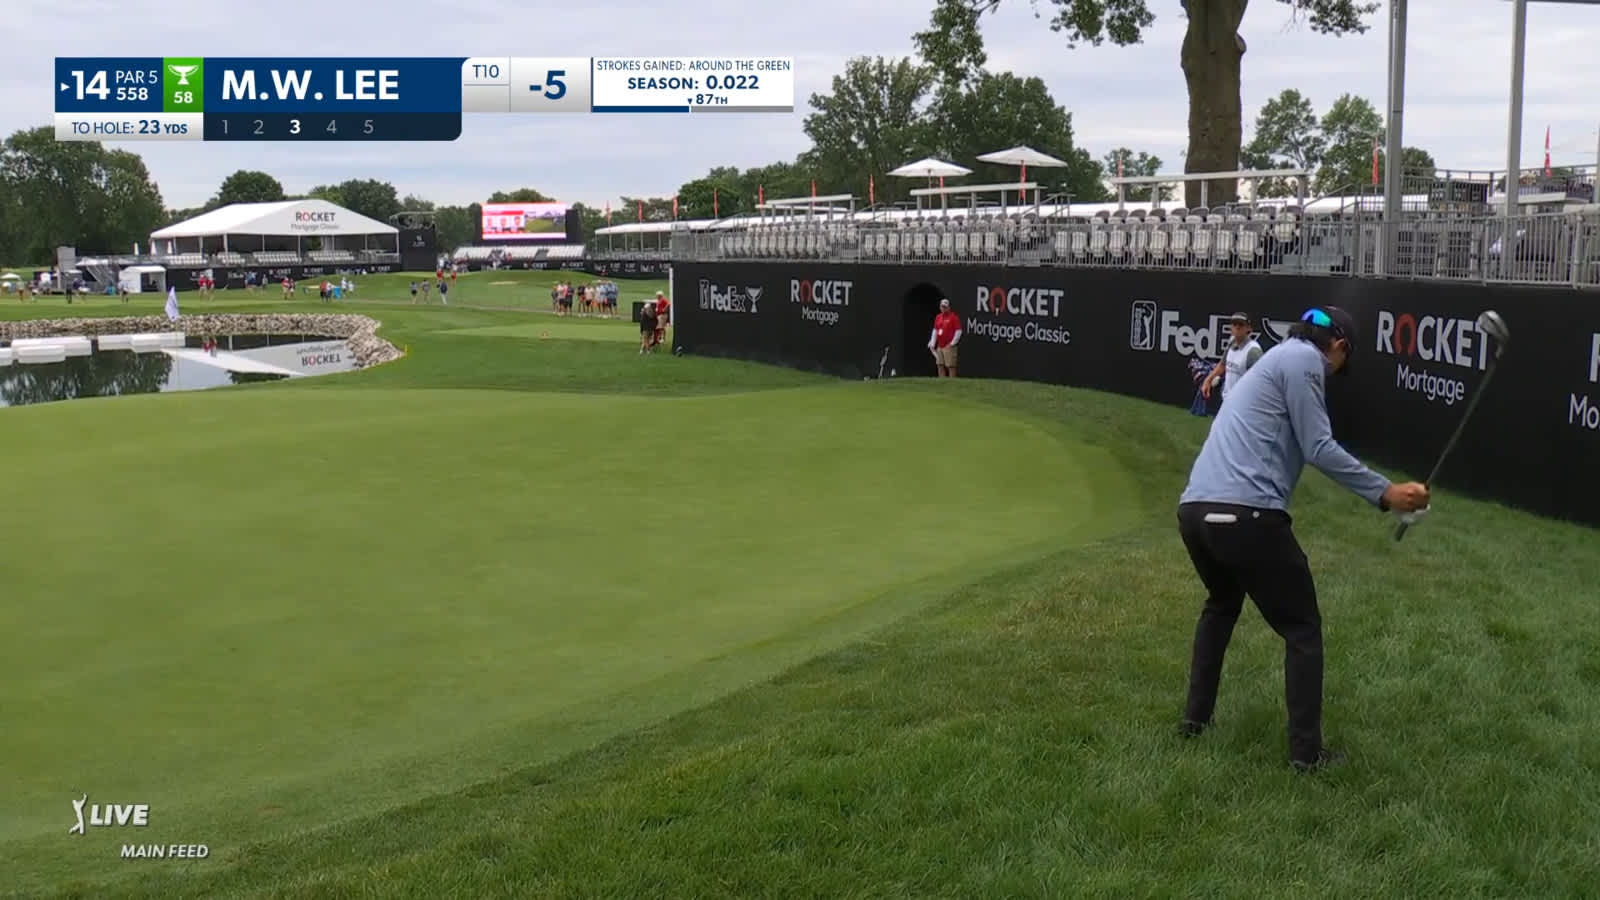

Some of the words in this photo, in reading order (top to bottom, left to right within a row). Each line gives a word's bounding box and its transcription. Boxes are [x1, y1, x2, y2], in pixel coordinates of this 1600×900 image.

[295, 211, 336, 222] ROCKET
[710, 284, 746, 312] FedEx
[790, 279, 853, 305] ROCKET
[976, 286, 1065, 317] ROCKET
[802, 305, 839, 325] Mortgage
[967, 317, 1022, 343] Mortgage
[1024, 321, 1071, 344] Classic
[1376, 311, 1489, 371] ROCKET
[1396, 363, 1465, 405] Mortgage
